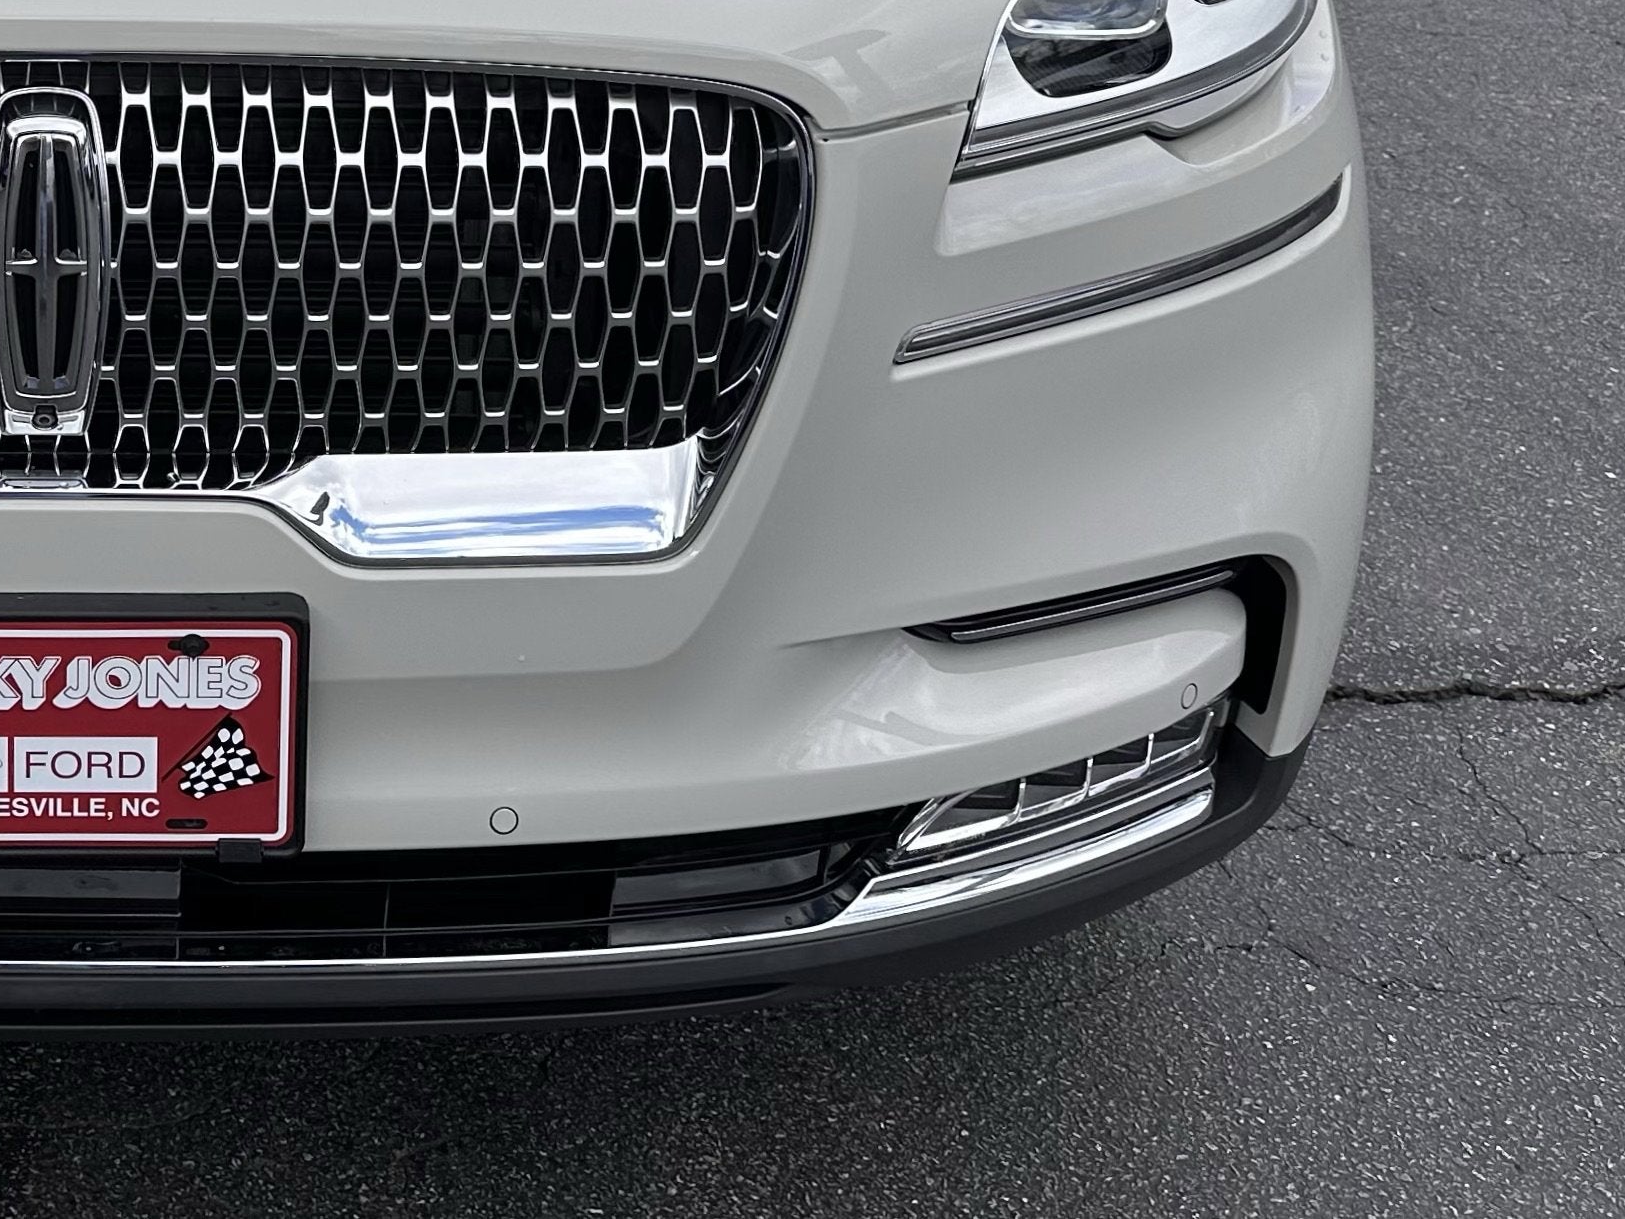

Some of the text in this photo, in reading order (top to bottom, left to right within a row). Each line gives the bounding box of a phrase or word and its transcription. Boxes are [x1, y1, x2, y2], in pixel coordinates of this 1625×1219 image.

[53, 655, 261, 711] JONES
[25, 751, 145, 779] FORD
[121, 797, 160, 817] NC
